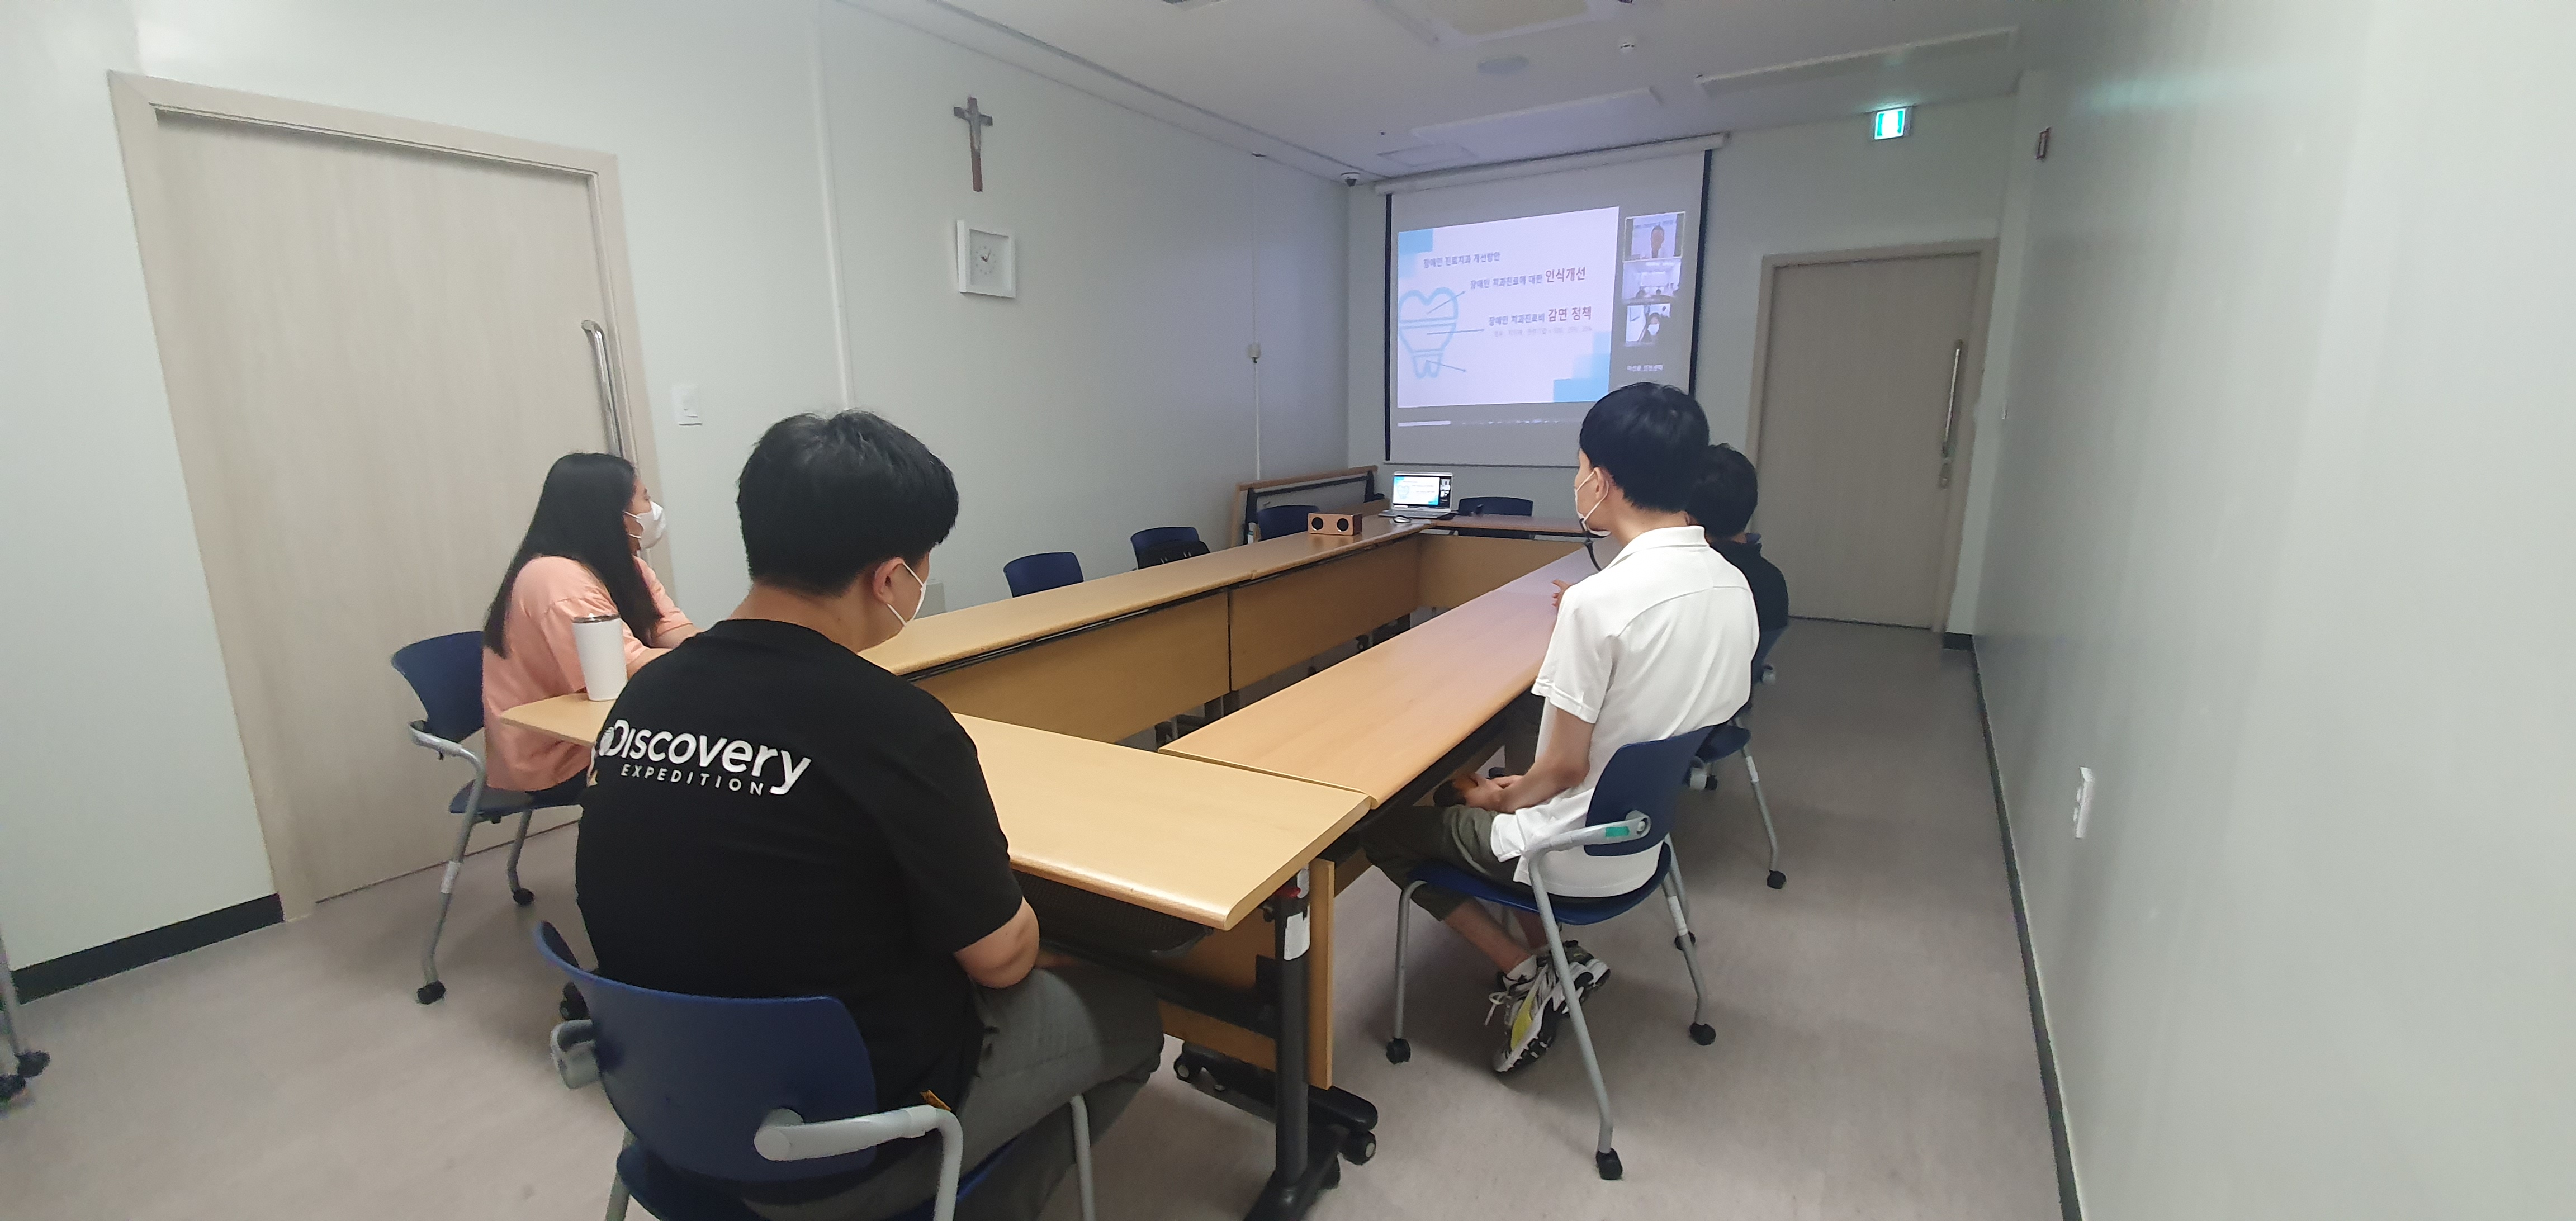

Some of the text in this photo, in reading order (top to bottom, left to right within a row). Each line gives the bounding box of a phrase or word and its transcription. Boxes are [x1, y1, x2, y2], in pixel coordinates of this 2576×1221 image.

[1546, 267, 1585, 282] 인식개선
[1549, 308, 1567, 322] 감면
[1571, 306, 1592, 320] 정책
[599, 719, 812, 795] Discovery
[621, 764, 764, 796] EXPEDITION
